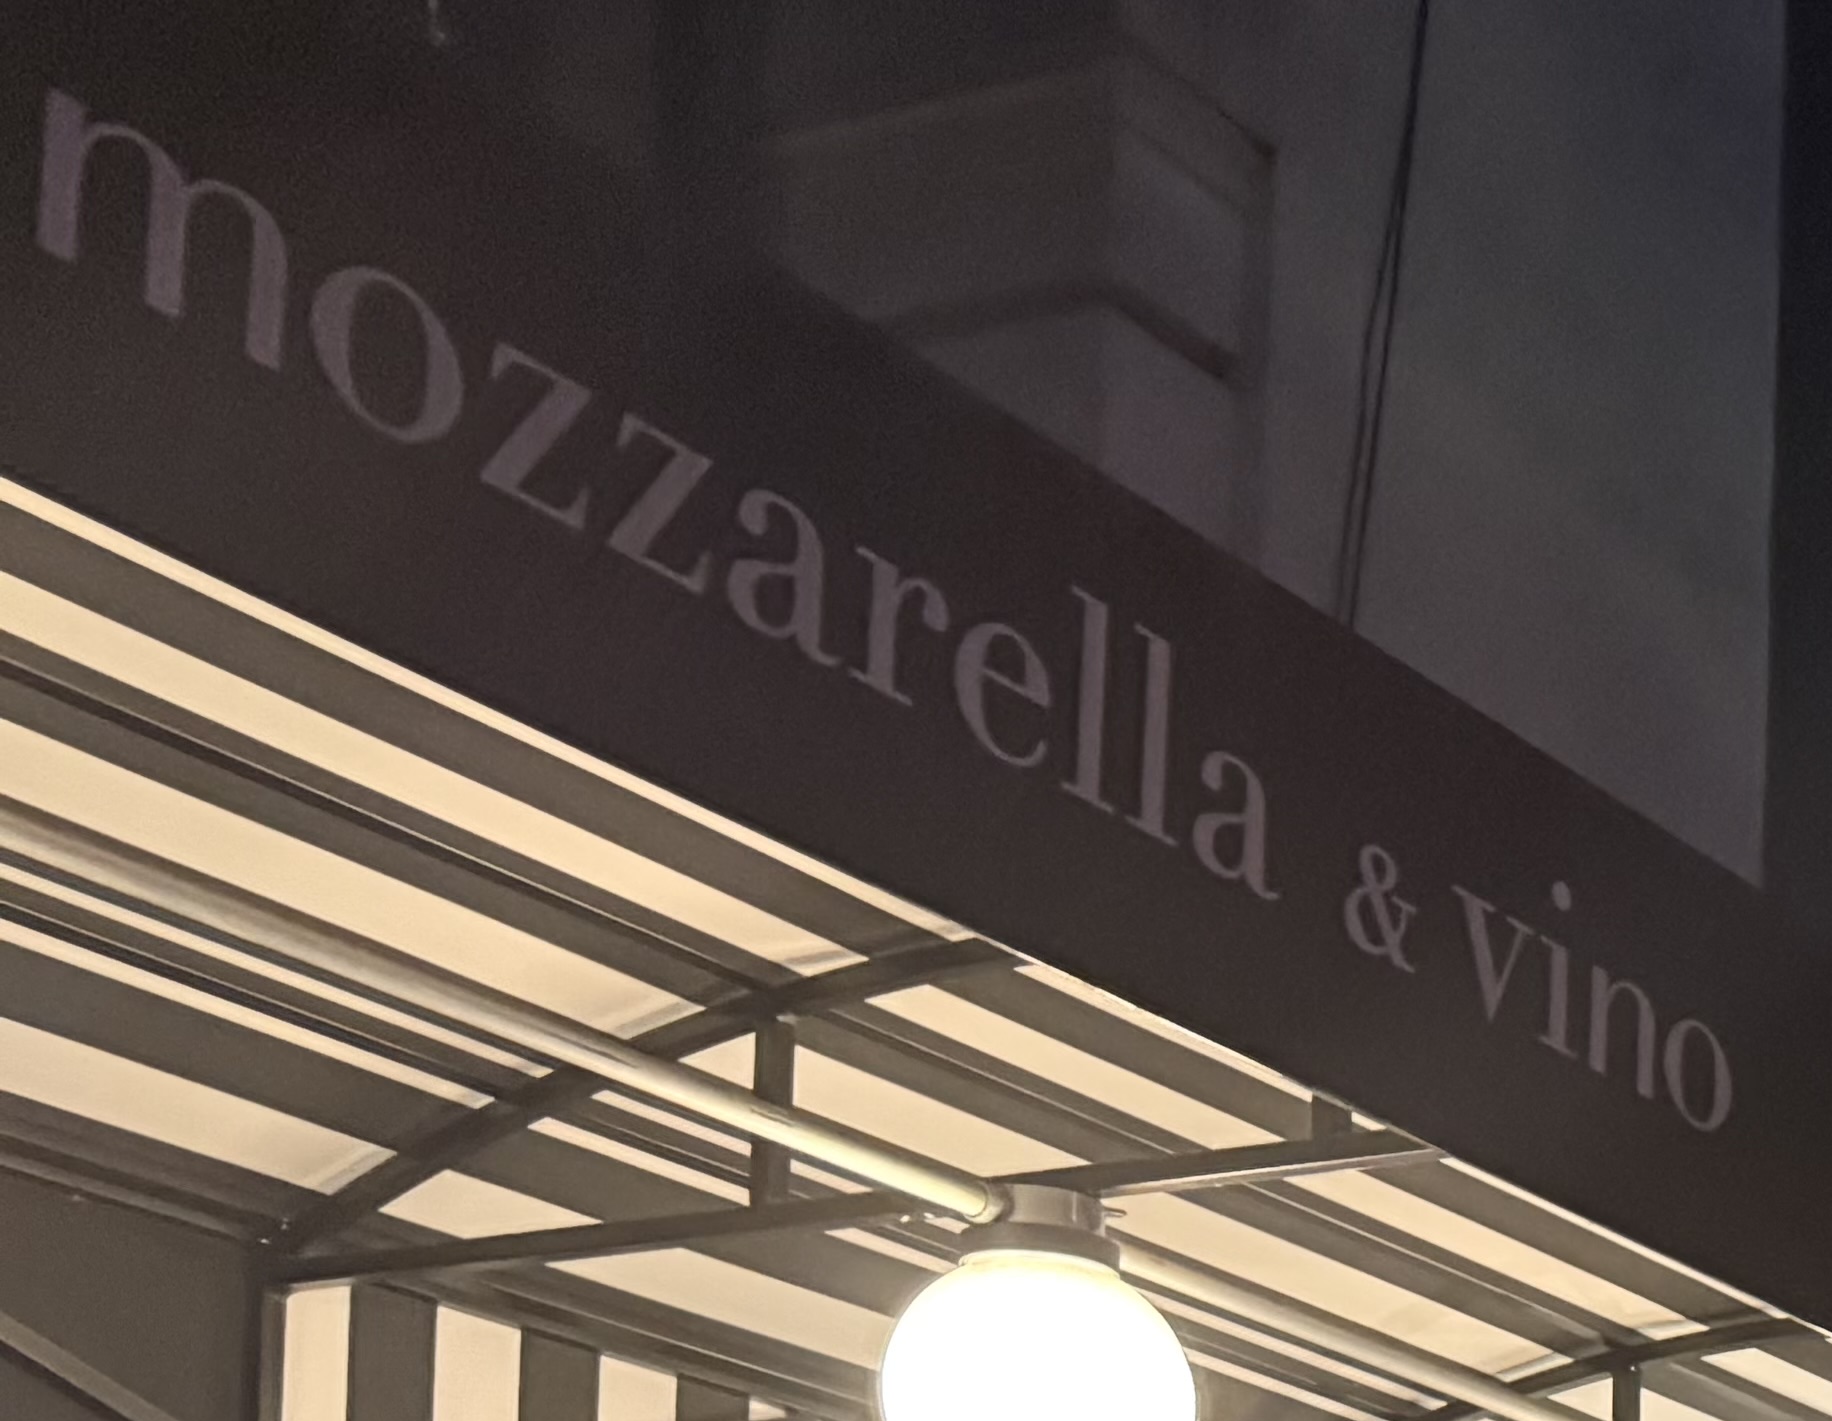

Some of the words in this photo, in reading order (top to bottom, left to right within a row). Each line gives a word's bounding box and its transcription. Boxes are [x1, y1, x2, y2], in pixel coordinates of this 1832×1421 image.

[36, 87, 1280, 903] mozzarella
[1343, 843, 1418, 975] &
[1452, 881, 1735, 1133] vino
